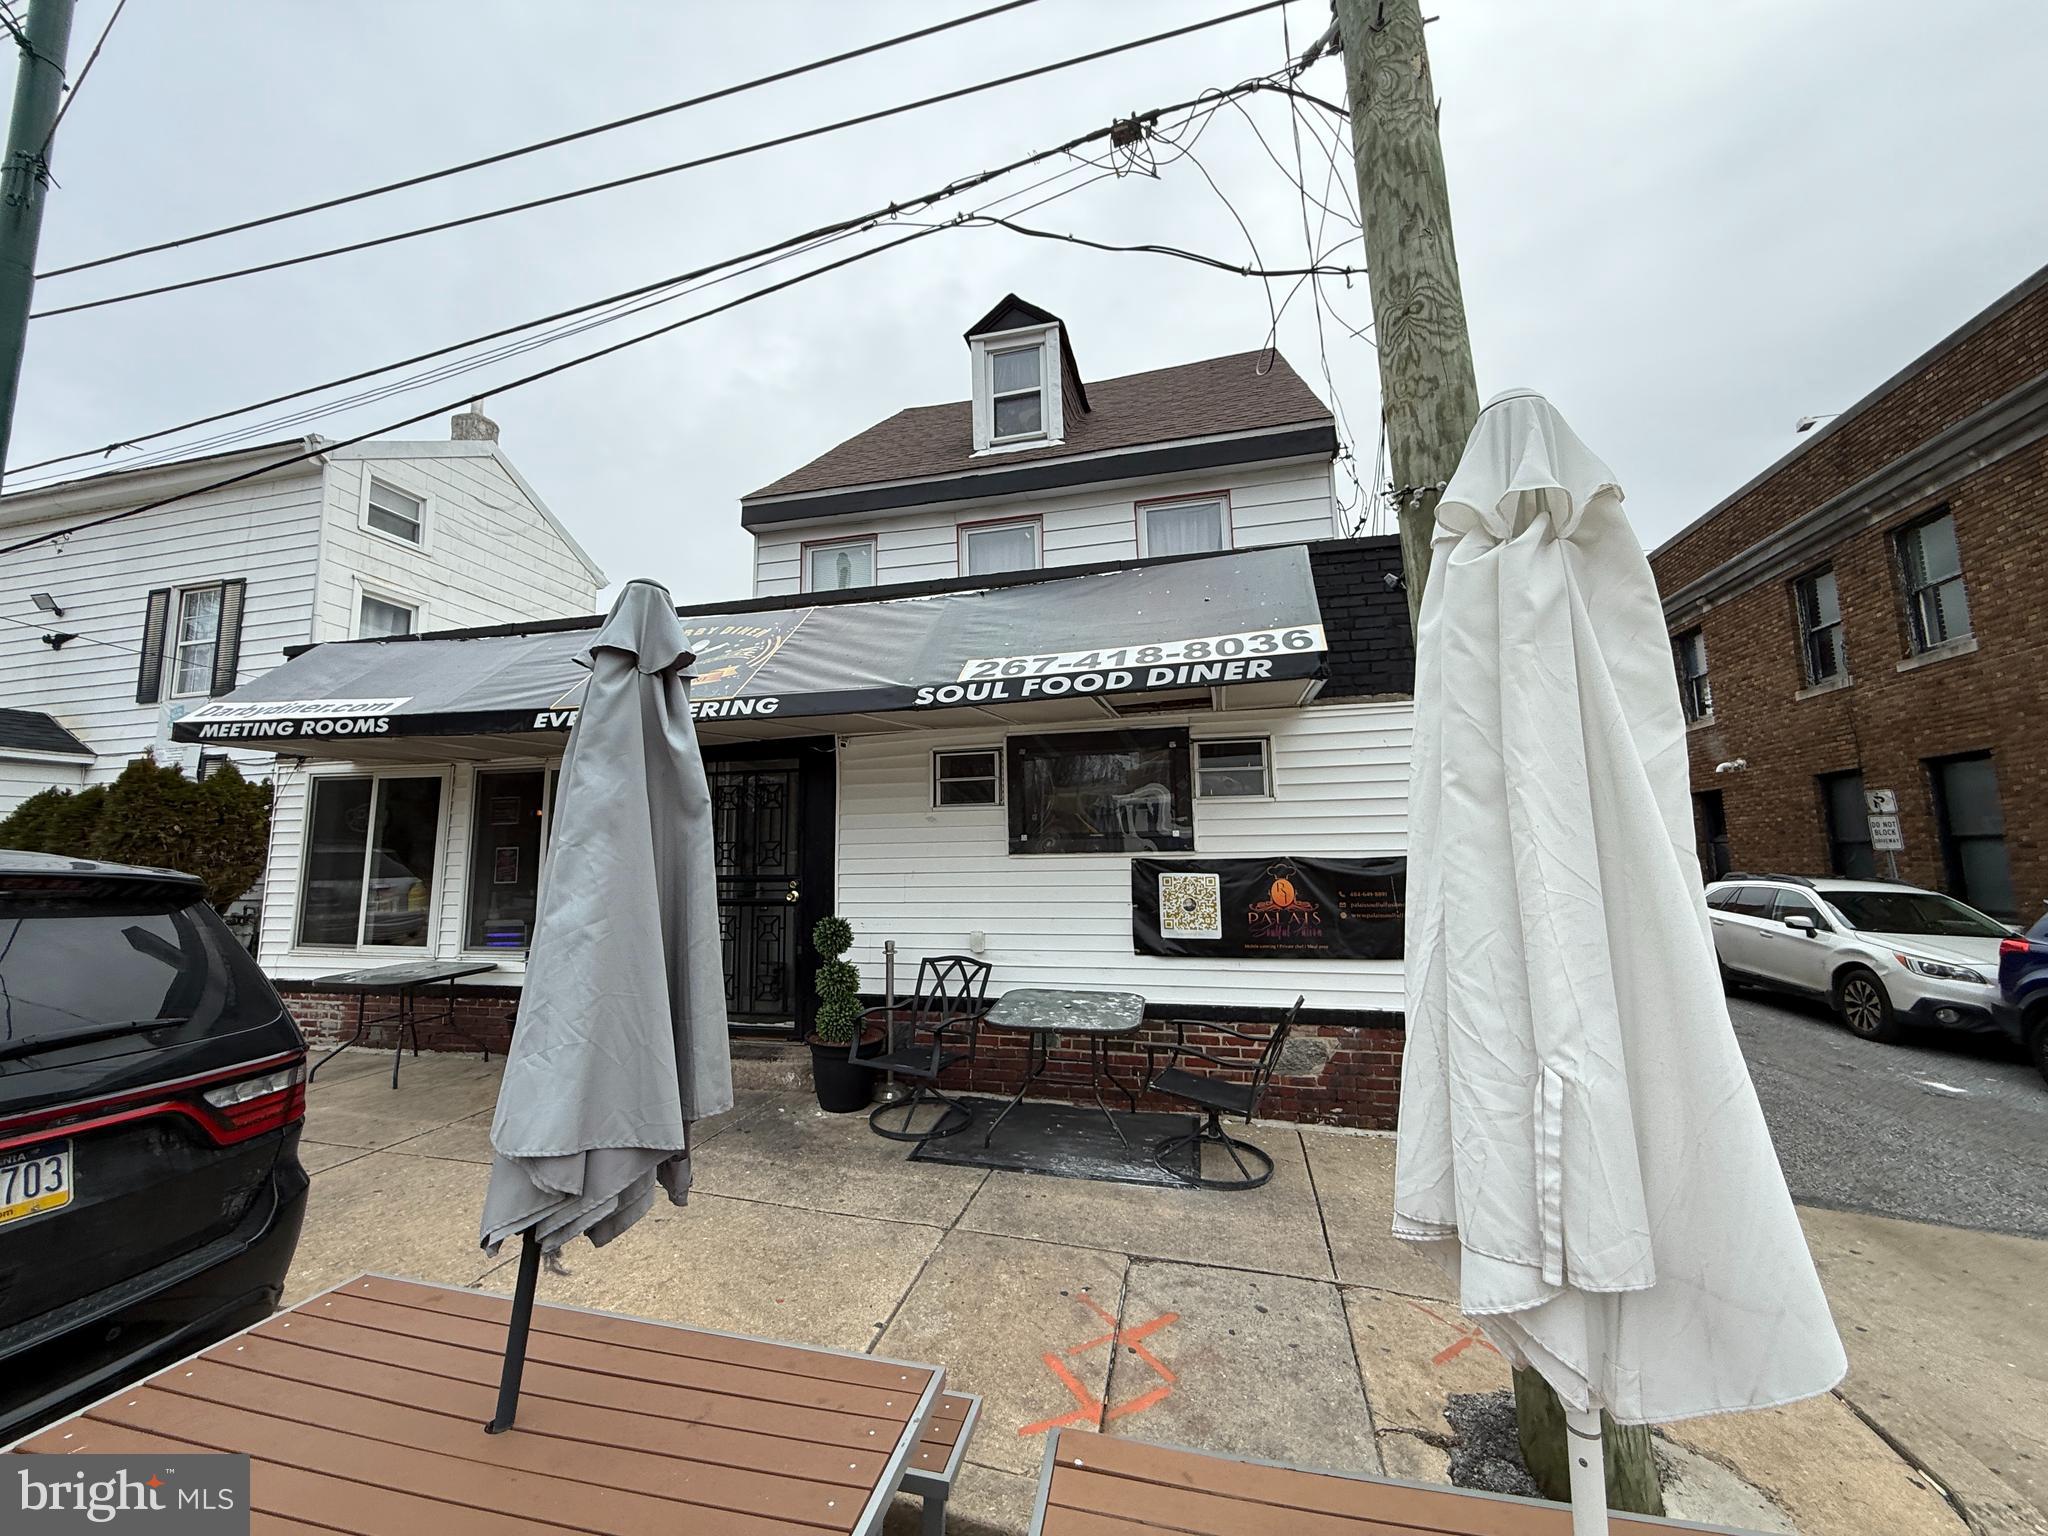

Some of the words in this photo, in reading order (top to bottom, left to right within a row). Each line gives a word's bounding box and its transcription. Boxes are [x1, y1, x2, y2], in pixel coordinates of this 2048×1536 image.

[969, 628, 1315, 679] 267-418-8036
[913, 681, 1009, 706] SOUL
[1021, 669, 1144, 697] FOOD
[1144, 658, 1273, 688] DINER
[195, 702, 394, 718] Darbydiner.com
[689, 697, 780, 719] ERING
[198, 721, 295, 738] MEETING
[299, 717, 390, 736] ROOMS
[533, 710, 579, 729] EVE
[1874, 828, 1896, 836] BLOCK
[0, 1152, 26, 1165] NIA
